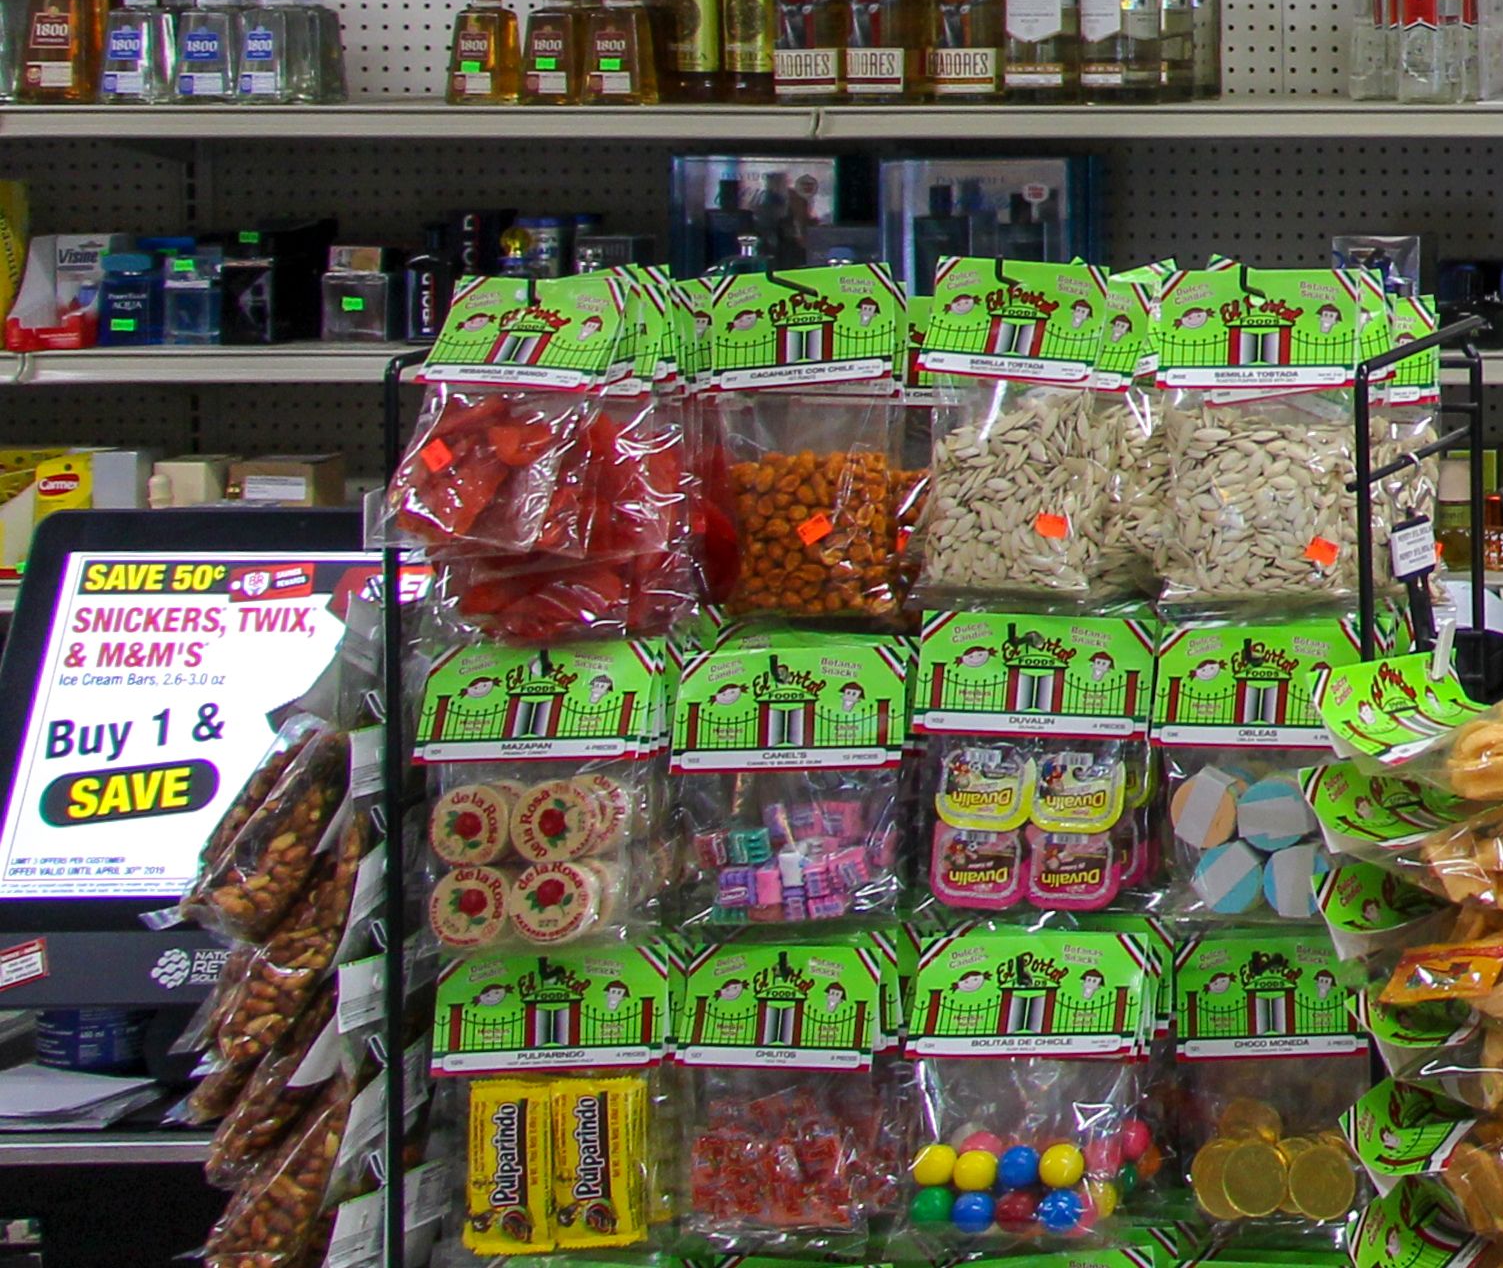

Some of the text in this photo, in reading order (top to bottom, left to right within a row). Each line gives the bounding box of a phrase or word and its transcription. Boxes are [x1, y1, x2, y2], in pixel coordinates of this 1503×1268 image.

[35, 22, 68, 37] 1800
[112, 39, 140, 51] 1800
[187, 40, 219, 52] 1800
[247, 39, 272, 51] 1800
[460, 39, 488, 51] 1800
[534, 39, 562, 51] 1800
[596, 39, 626, 51] 1800
[57, 248, 98, 264] Visine
[969, 359, 1047, 372] SEMILLA TOSTADA
[749, 364, 856, 380] CACAHUATE CON CHILE
[1214, 370, 1300, 379] SEMILLA TOSTADA
[84, 564, 227, 591] SAVE 50¢
[63, 641, 205, 668] & M&M'S
[59, 673, 79, 687] Ice
[82, 673, 124, 687] Cream
[127, 673, 159, 687] Bars,
[211, 674, 227, 685] oz
[1009, 716, 1056, 726] DUVALIN
[45, 702, 225, 761] Buy 1 &
[1238, 729, 1278, 738] OBLEAS
[501, 742, 553, 751] MAZAPAN
[762, 751, 808, 760] CANEL'S
[66, 767, 192, 819] SAVE
[953, 790, 1011, 808] Duvalin
[1046, 791, 1106, 809] Duvalin
[9, 867, 37, 876] OFFER
[39, 867, 65, 876] VALID
[68, 867, 91, 875] UNTIL
[550, 861, 583, 887] Rosa
[948, 867, 1009, 886] Duvalin
[1041, 867, 1100, 886] Duvalin
[971, 1037, 1073, 1048] BOLITAS DE CHICLE
[1233, 1039, 1310, 1048] CHOCO MONEDA
[516, 1050, 585, 1060] PULPARINDO
[755, 1050, 796, 1059] CHILITOS
[573, 1096, 600, 1199] Pulparindo
[490, 1101, 518, 1208] Pulparindo
